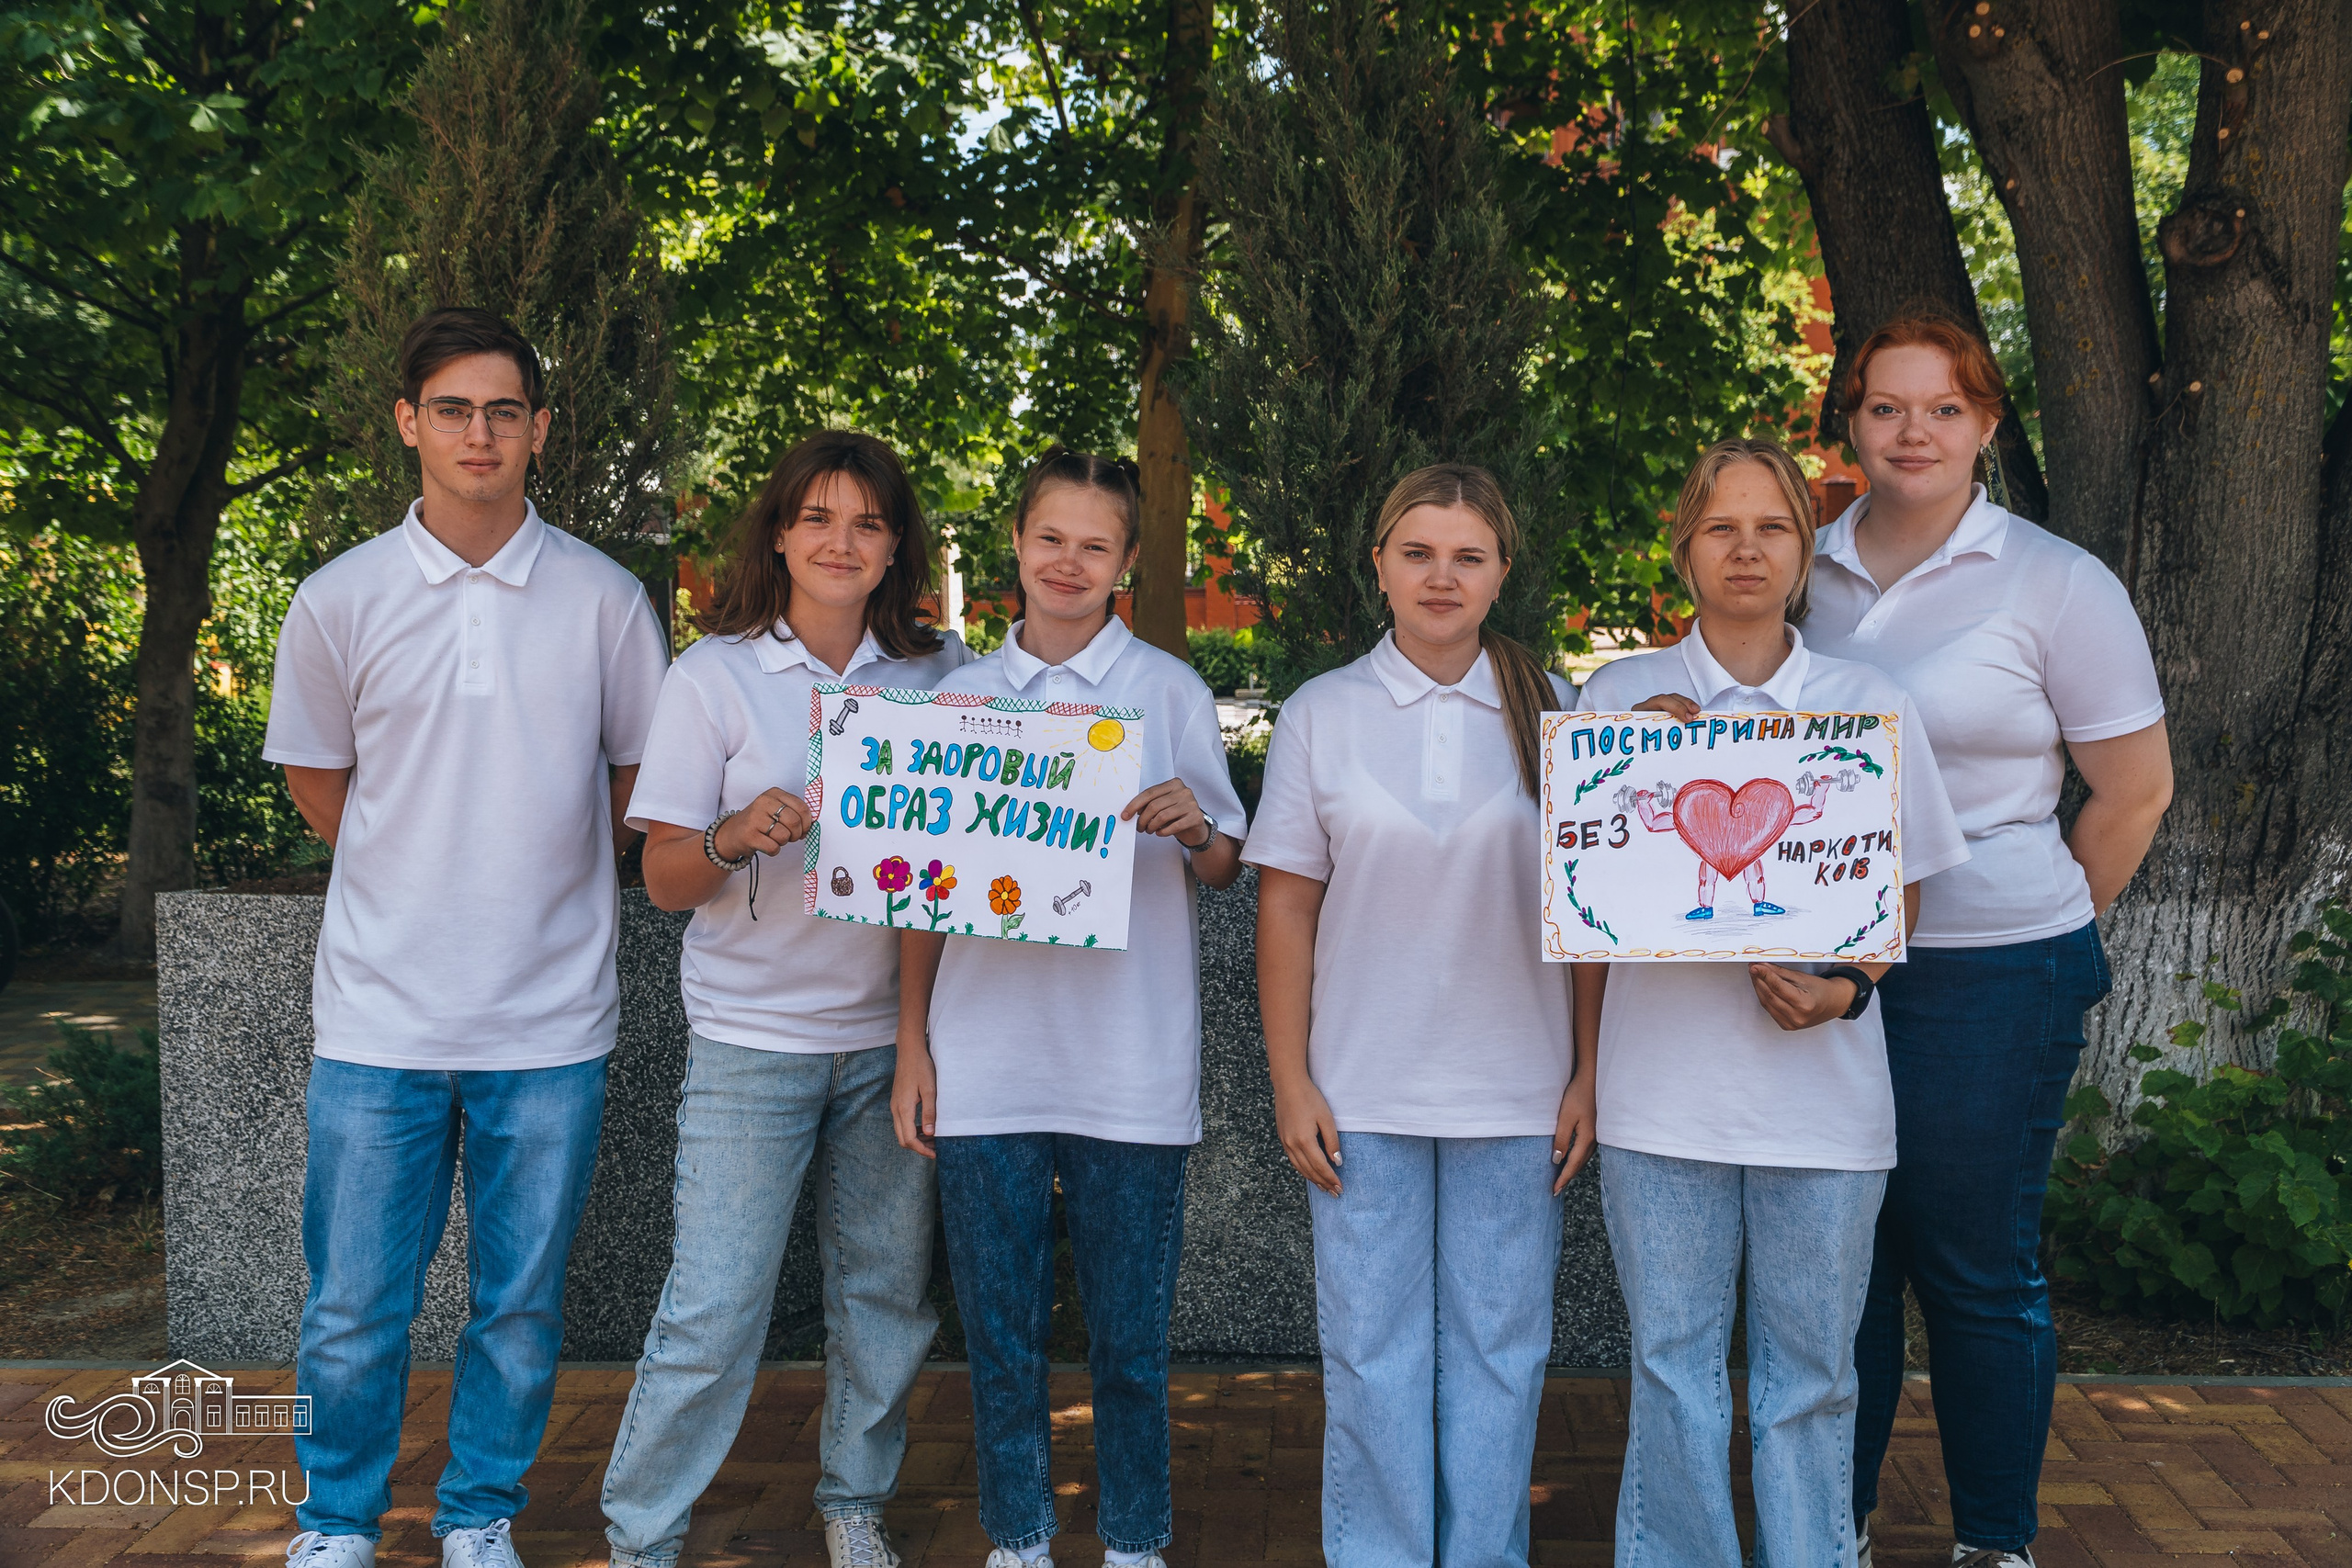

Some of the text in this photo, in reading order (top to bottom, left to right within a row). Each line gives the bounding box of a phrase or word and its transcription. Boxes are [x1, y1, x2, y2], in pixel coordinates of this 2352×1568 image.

[1804, 714, 1880, 740] МИР
[860, 736, 1076, 790] ЗА ЗДОРОВЫЙ
[840, 784, 1116, 859] ОБРАЗ ЖИЗНИ!
[1556, 813, 1631, 850] БЕЗ
[1778, 829, 1893, 863] НАРКОТИ
[1814, 857, 1871, 886] КОВ
